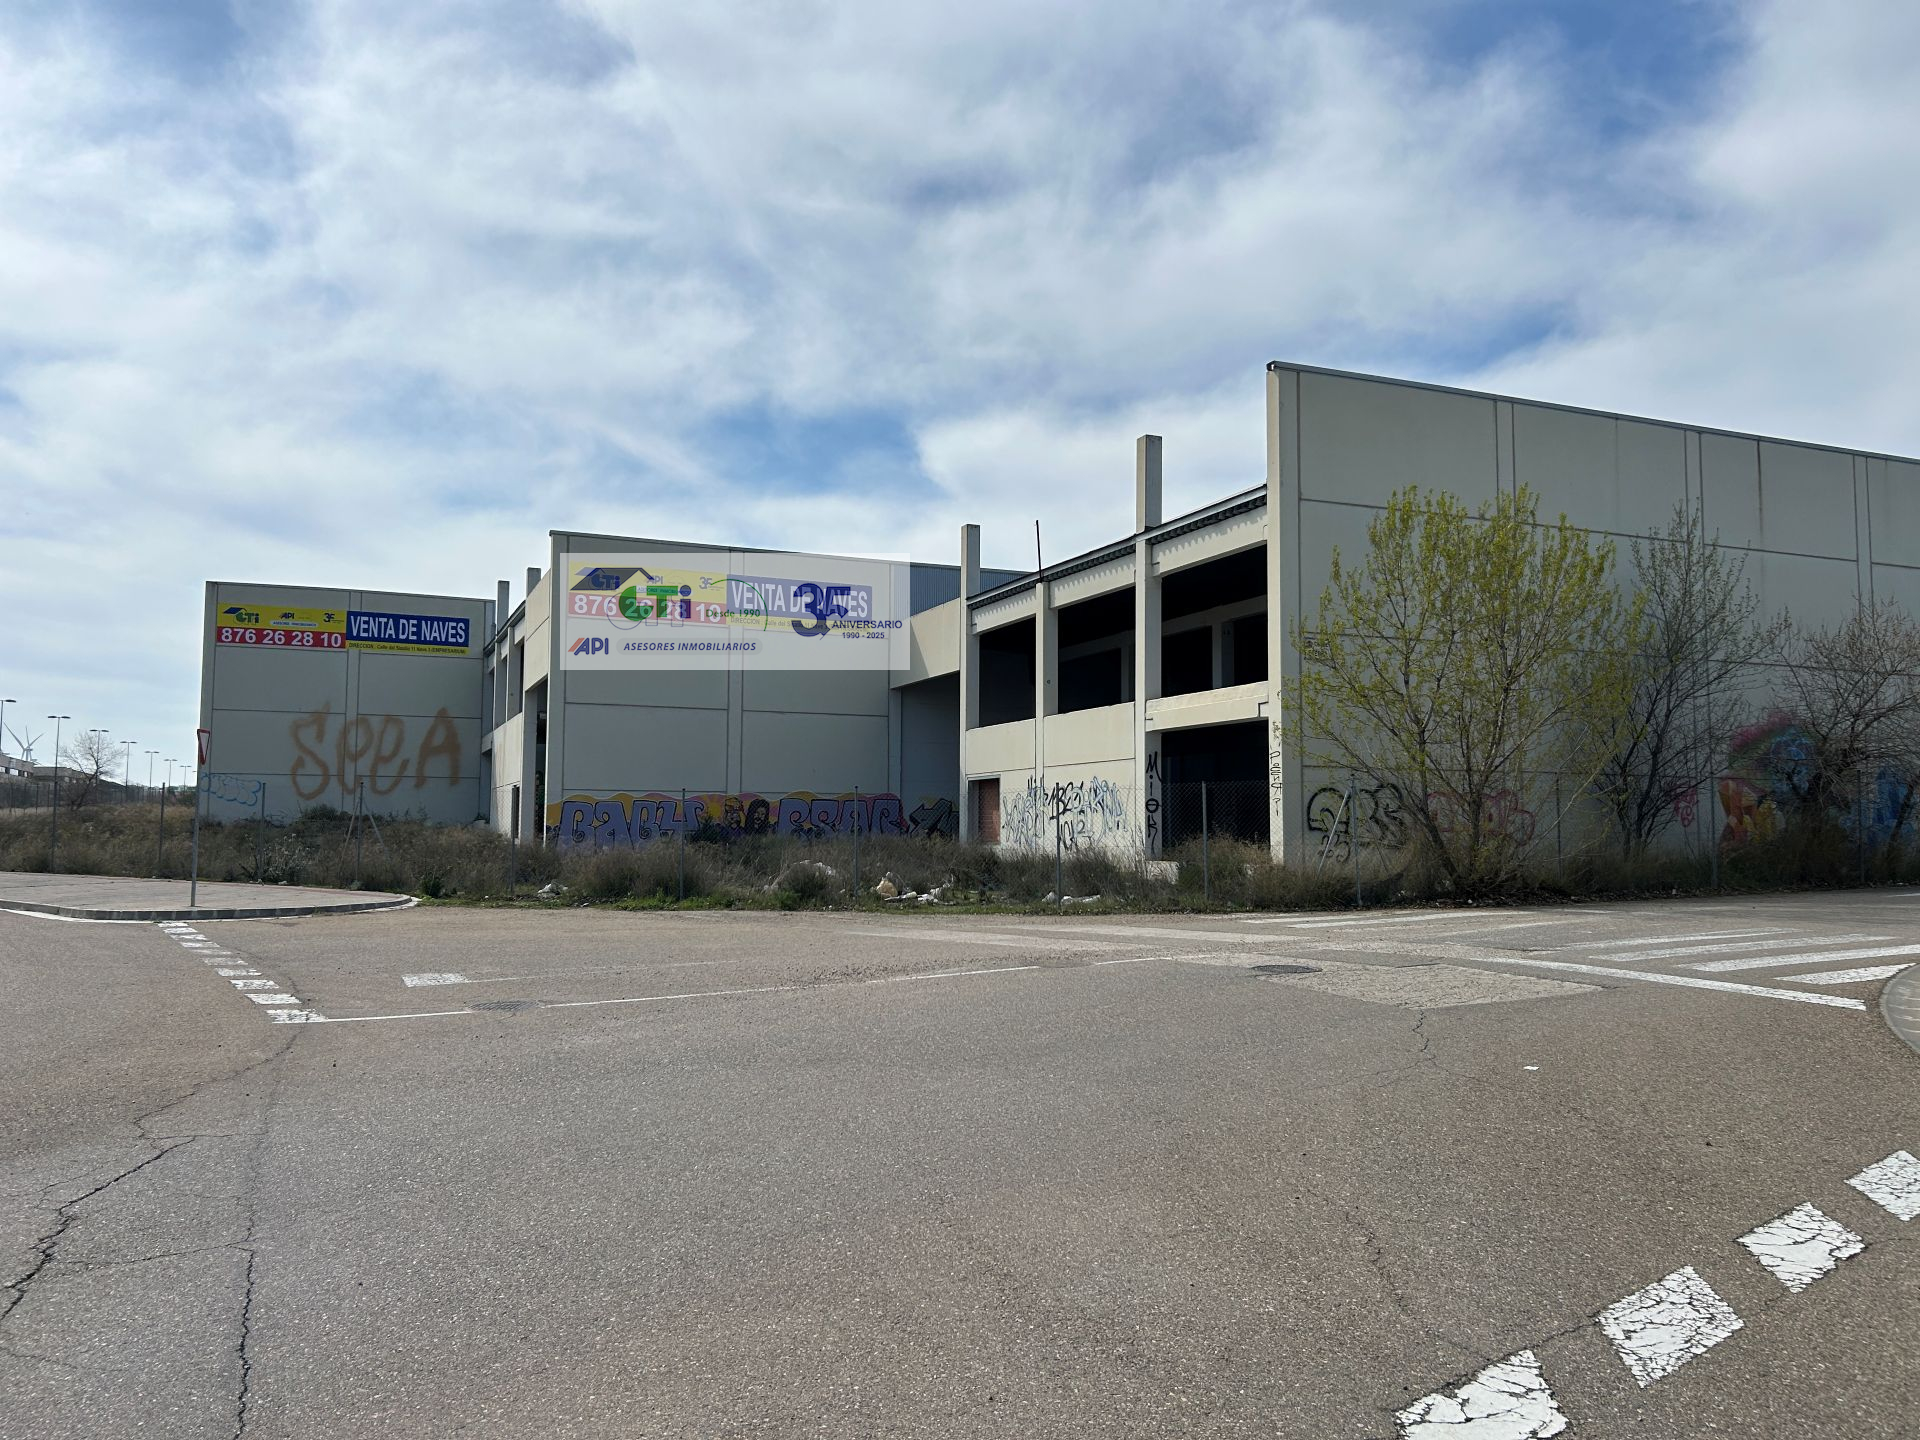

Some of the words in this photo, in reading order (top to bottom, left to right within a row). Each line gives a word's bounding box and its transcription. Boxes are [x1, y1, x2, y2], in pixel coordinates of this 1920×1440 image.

[574, 594, 617, 616] 876
[696, 603, 721, 623] 10
[731, 581, 786, 612] VENTA
[221, 628, 256, 643] 876
[262, 630, 285, 644] 26
[292, 632, 313, 646] 28
[320, 633, 342, 647] 10
[351, 615, 396, 639] VENTA
[399, 619, 418, 640] DE
[421, 620, 466, 643] NAVES
